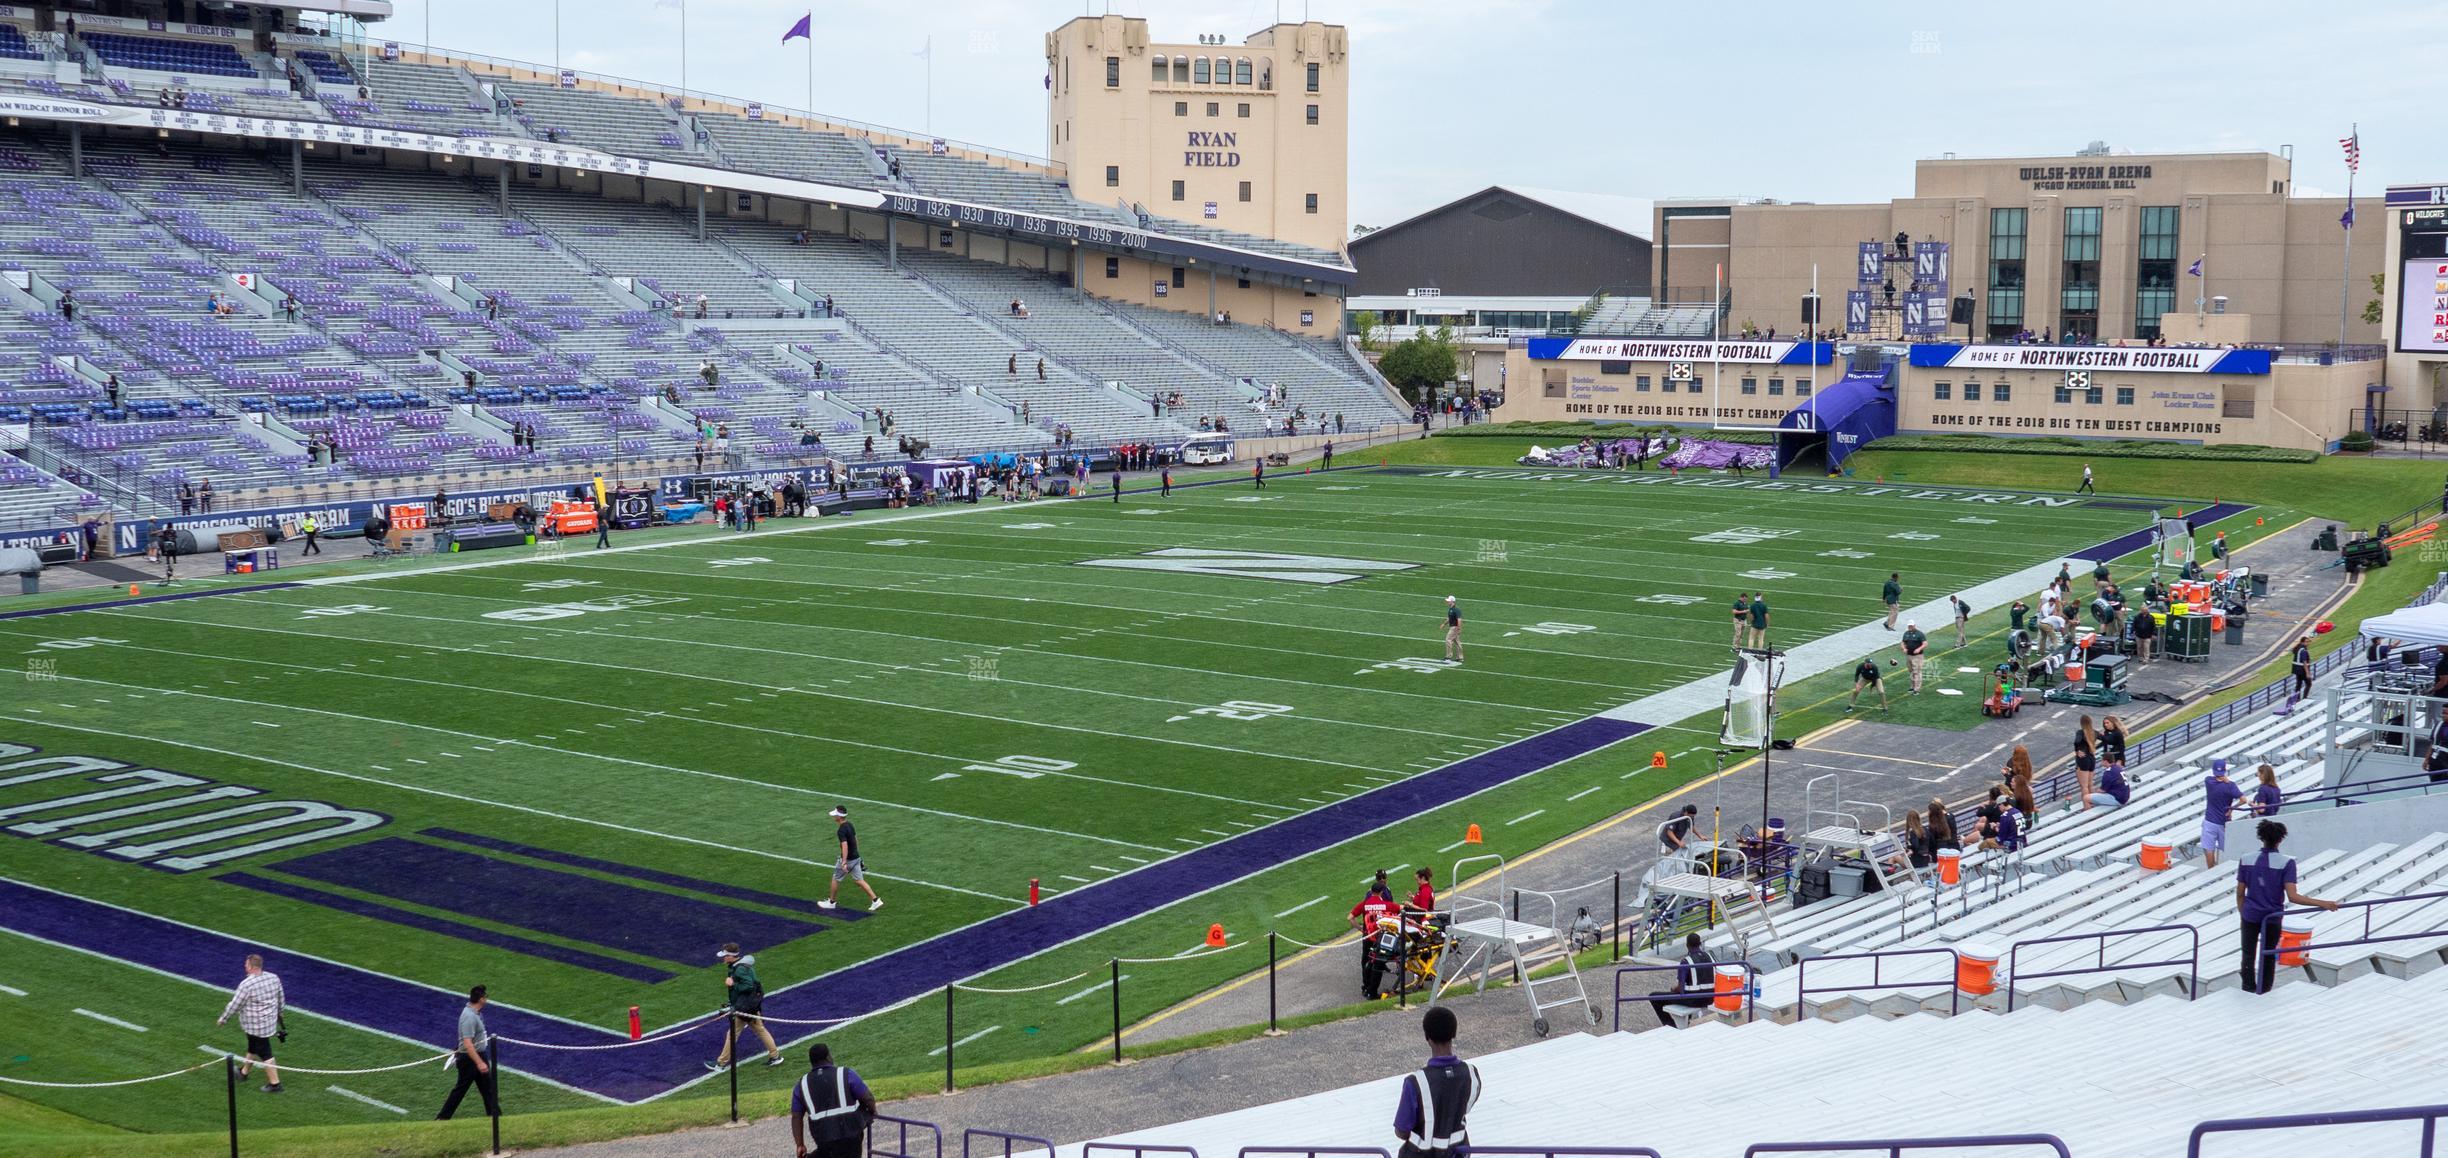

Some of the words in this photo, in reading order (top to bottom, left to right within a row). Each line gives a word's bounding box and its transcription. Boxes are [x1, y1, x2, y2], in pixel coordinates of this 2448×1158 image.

[186, 24, 220, 36] WILDCAT
[221, 27, 235, 38] DEN
[561, 75, 575, 85] 232
[15, 103, 50, 111] WILDCAT
[53, 106, 80, 114] HONOR
[83, 108, 102, 116] ROLL
[1188, 131, 1236, 147] RYAN
[1184, 152, 1241, 167] FIELD
[2020, 167, 2104, 180] WELSH-RYAN
[2108, 165, 2152, 179] ARENA
[2066, 181, 2111, 190] MEMORIAL
[2113, 181, 2136, 190] HALL
[2415, 210, 2445, 218] WILDCATS
[894, 197, 918, 212] 1903
[927, 201, 951, 217] 1926
[960, 207, 984, 222] 1930
[993, 211, 1015, 227] 1931
[1023, 217, 1047, 232] 1936
[1056, 222, 1079, 237] 1995
[1088, 227, 1112, 243] 1996
[1120, 232, 1148, 248] 2000
[1864, 253, 1877, 273] N
[1920, 253, 1934, 274] N
[1155, 285, 1167, 293] 135
[1852, 301, 1866, 322] N
[1908, 303, 1922, 324] N
[2435, 314, 2445, 325] R
[1579, 345, 1602, 355] HOME
[1607, 346, 1617, 356] OF
[1621, 343, 1712, 358] NORTHWESTERN
[1717, 345, 1773, 360] FOOTBALL
[1969, 351, 1998, 362] HOME
[2002, 353, 2016, 363] OF
[2020, 349, 2129, 367] NORTHWESTERN
[2132, 352, 2200, 370] FOOTBALL
[1673, 364, 1691, 379] 25
[2068, 371, 2090, 388] 25
[1572, 385, 1592, 393] Sports
[1592, 385, 1619, 394] Medicine
[2152, 391, 2170, 399] John
[2171, 391, 2195, 399] Evans
[2197, 391, 2216, 400] Club
[1566, 403, 1593, 413] HOME
[1597, 404, 1609, 414] OF
[1614, 405, 1633, 415] THE
[1638, 406, 1661, 417] 2018
[1666, 407, 1684, 417] BIG
[1688, 408, 1709, 417] TEN
[1713, 408, 1744, 419] WEST
[2164, 400, 2191, 408] Locker
[2192, 401, 2215, 409] Room
[1797, 413, 1808, 429] N
[1932, 415, 1964, 425] HOME
[1969, 416, 1983, 426] OF
[1988, 417, 2011, 427] THE
[2017, 418, 2045, 428] 2018
[2050, 419, 2071, 430] BIG
[2076, 419, 2100, 430] TEN
[2106, 420, 2141, 431] WEST
[2146, 421, 2222, 434] CHAMPIONS
[1427, 470, 2084, 508] NORTHWESTERN
[373, 503, 385, 521] N
[121, 525, 137, 549] N
[1190, 700, 1294, 721] 20
[961, 755, 1079, 779] 10
[1653, 757, 1665, 766] 20
[1470, 830, 1480, 840] 10
[1212, 931, 1220, 940] G
